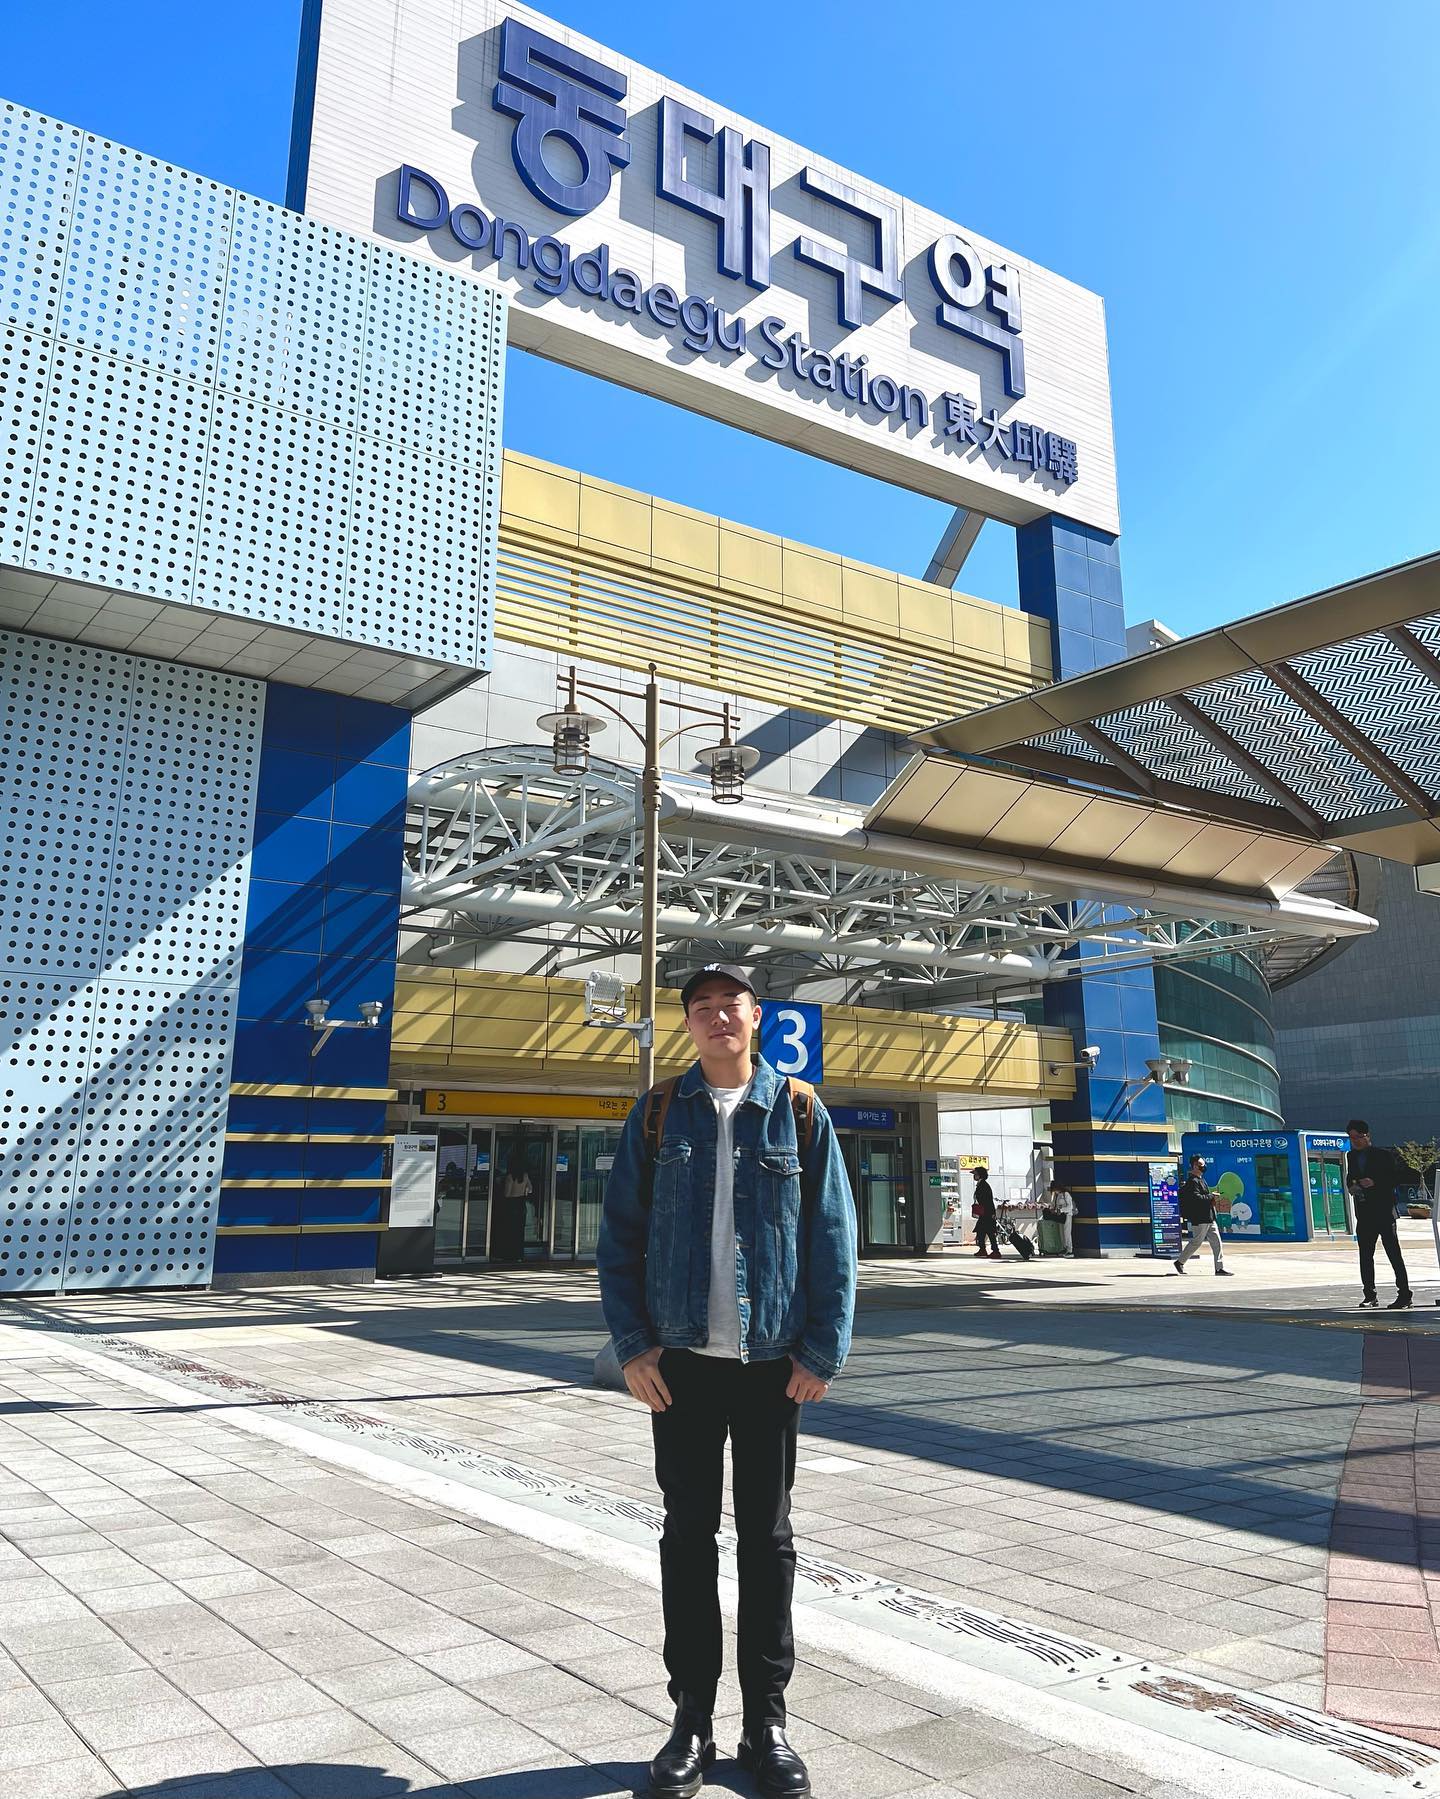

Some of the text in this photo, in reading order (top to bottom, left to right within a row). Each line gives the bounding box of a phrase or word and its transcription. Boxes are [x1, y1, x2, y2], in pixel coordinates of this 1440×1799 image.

[493, 16, 1025, 398] 동대구역
[397, 163, 929, 427] Dongdaegu Station
[941, 390, 1078, 485] 東大邱驛
[775, 1009, 809, 1074] 3
[436, 1092, 447, 1111] 3
[599, 1100, 618, 1110] 나오는
[857, 1111, 879, 1120] 들어가는
[1230, 1139, 1272, 1148] DGB대구은행
